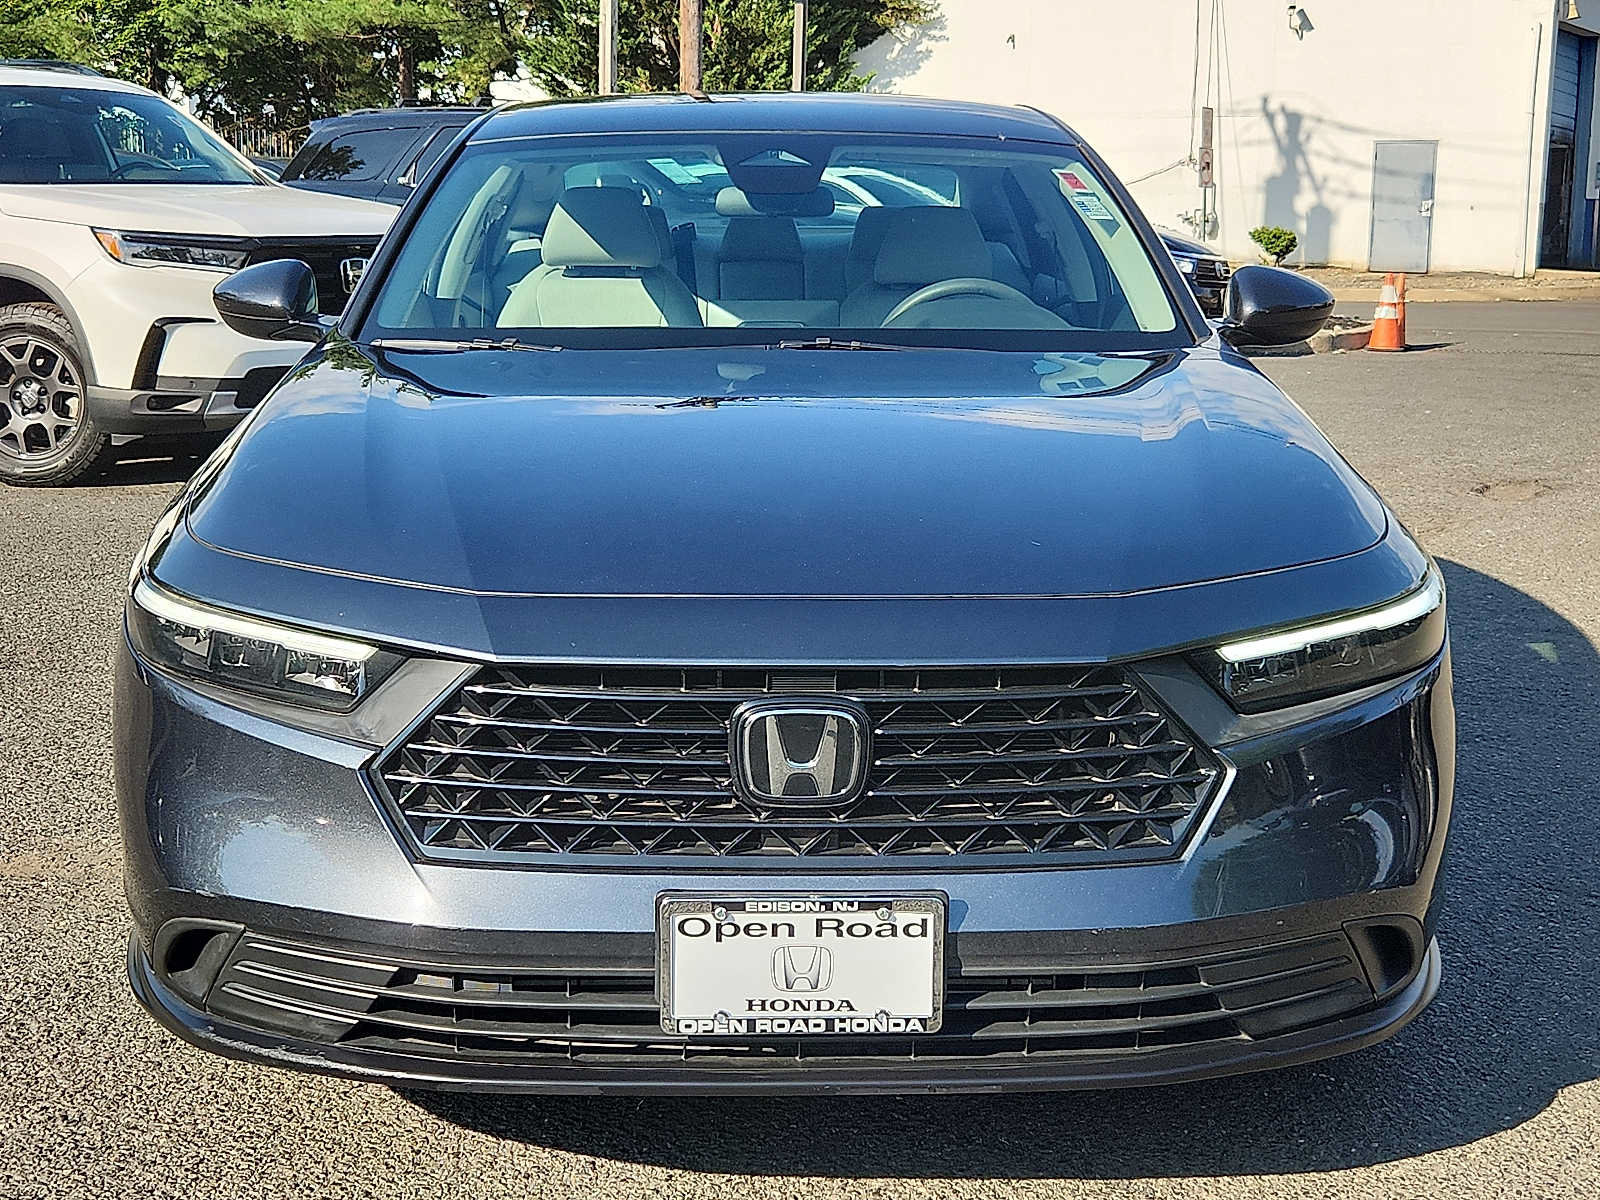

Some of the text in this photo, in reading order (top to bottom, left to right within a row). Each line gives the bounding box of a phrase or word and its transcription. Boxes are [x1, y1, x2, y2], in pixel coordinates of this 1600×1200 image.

[745, 901, 859, 912] EDISON, NJ
[677, 917, 928, 942] Open Road
[745, 999, 857, 1012] HONDA
[679, 1019, 924, 1033] OPEN ROAD HONDA
